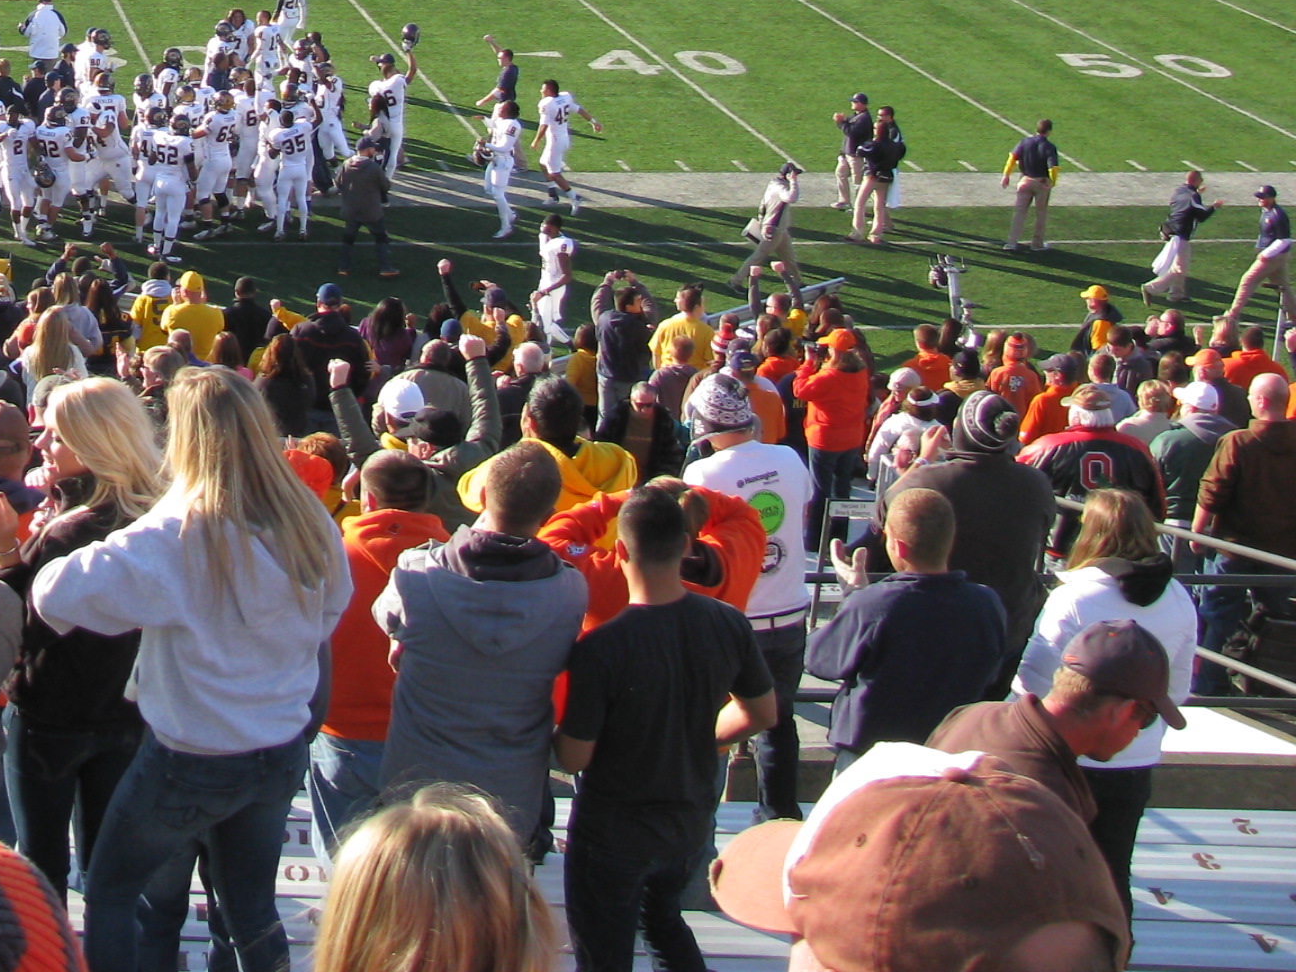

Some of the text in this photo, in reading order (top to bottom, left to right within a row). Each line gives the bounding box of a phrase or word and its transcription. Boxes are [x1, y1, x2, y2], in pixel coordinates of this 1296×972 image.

[587, 49, 748, 76] 40
[1055, 53, 1232, 79] 50
[13, 140, 23, 155] 2
[156, 143, 179, 165] 52
[281, 133, 305, 155] 35
[1232, 817, 1259, 835] 2
[1192, 852, 1222, 870] 3
[1147, 886, 1175, 906] 4
[1248, 933, 1279, 954] 4
